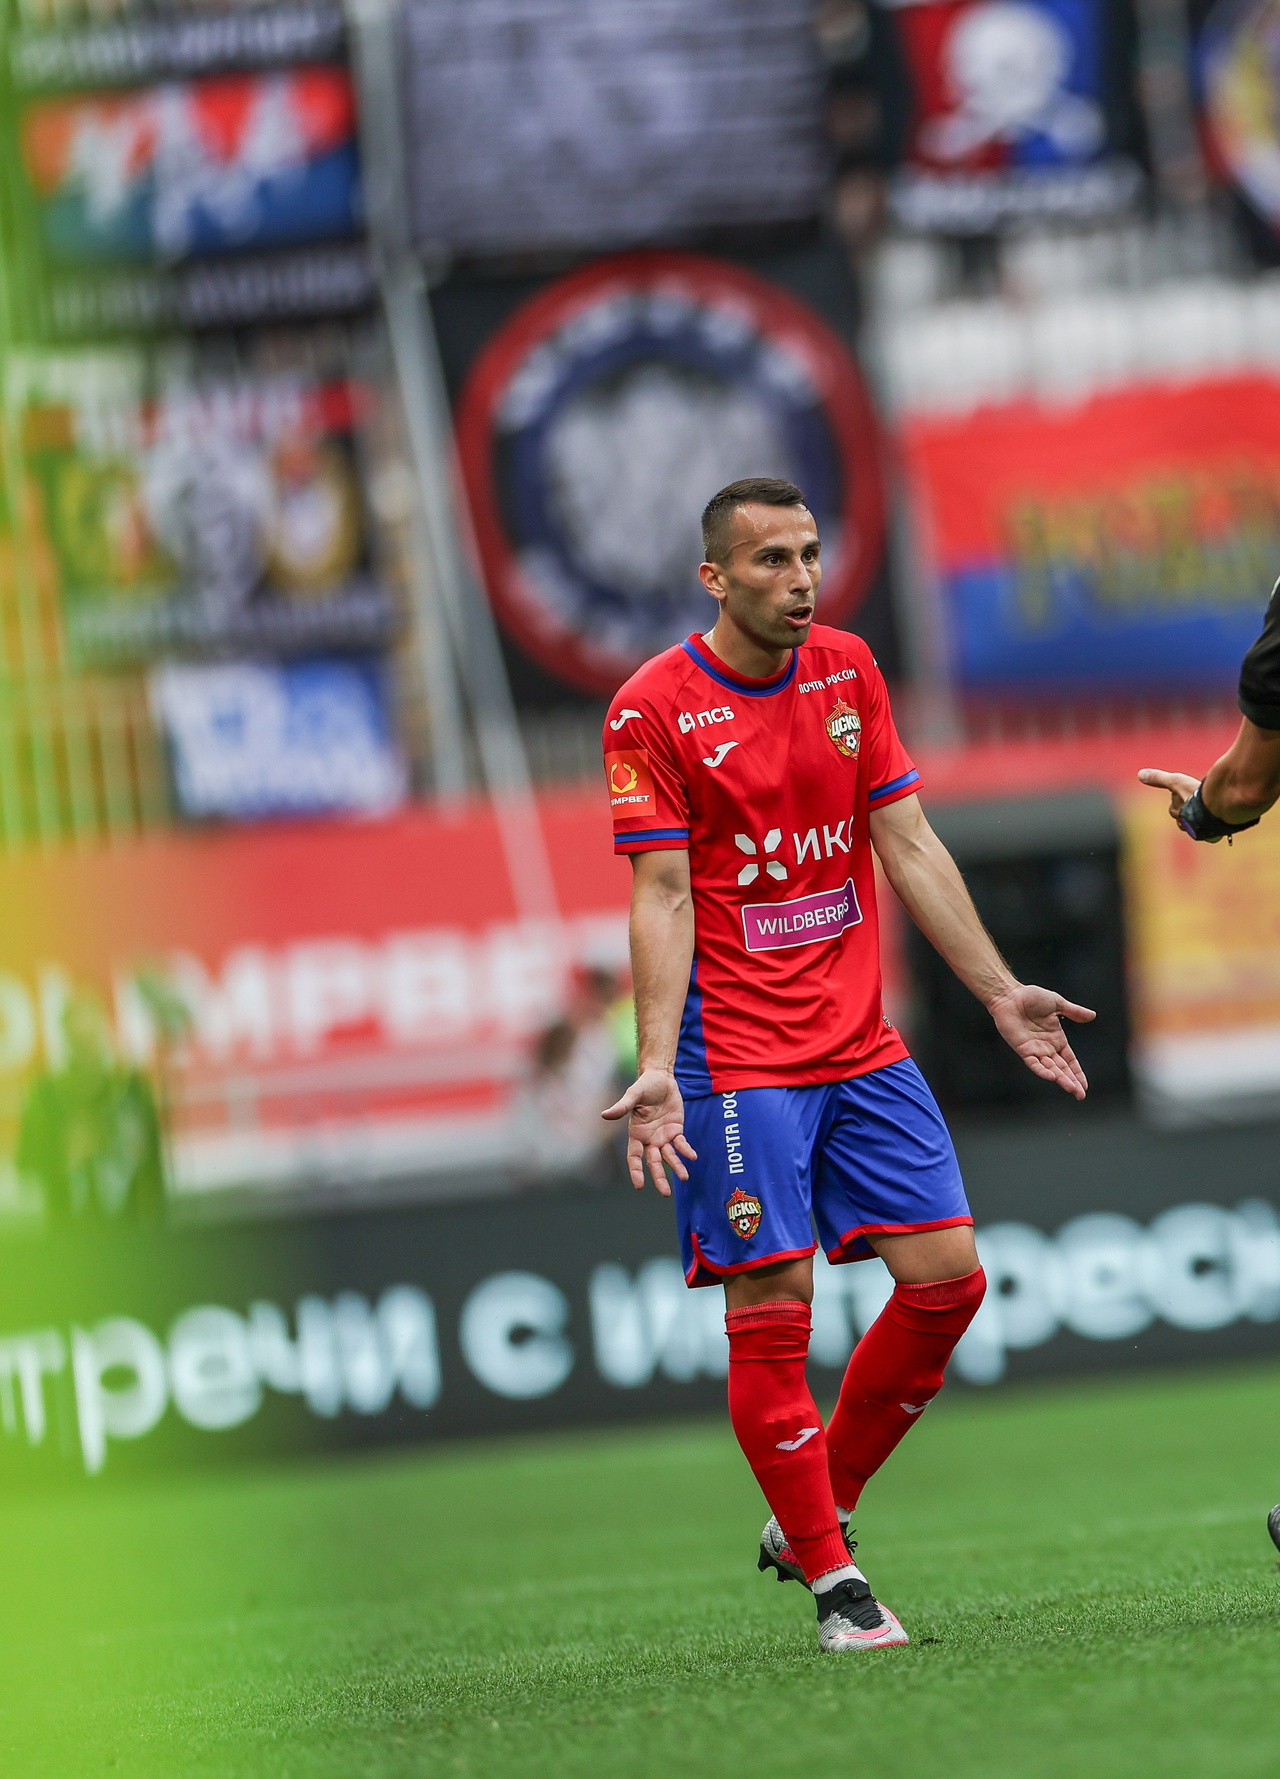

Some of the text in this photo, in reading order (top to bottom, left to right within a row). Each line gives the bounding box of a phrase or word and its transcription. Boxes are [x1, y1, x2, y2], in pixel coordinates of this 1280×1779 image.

[798, 680, 826, 695] ПОЧТА
[696, 705, 736, 728] ПСБ
[831, 714, 861, 738] ЦСКА
[611, 794, 650, 806] MPBET
[725, 1122, 745, 1175] ПОЧТА
[728, 1201, 760, 1220] ЦСКА
